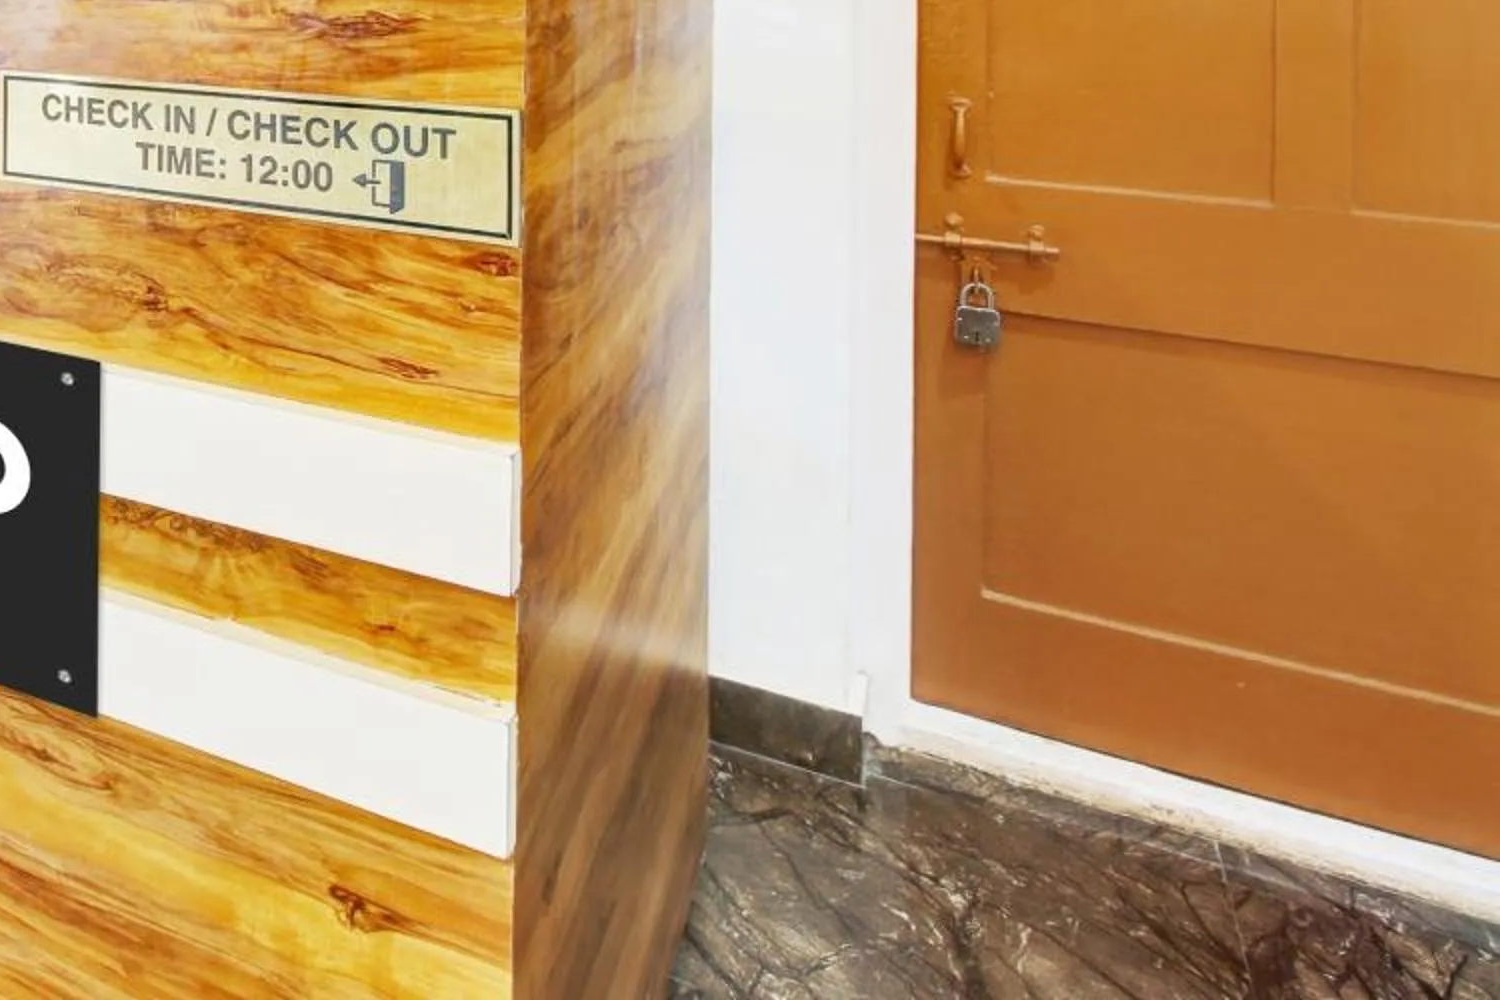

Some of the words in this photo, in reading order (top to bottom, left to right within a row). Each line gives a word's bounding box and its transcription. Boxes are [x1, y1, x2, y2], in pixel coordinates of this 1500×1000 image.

[41, 93, 154, 132] CHECK
[164, 107, 197, 136] IN
[227, 110, 359, 151] CHECK
[370, 122, 458, 160] OUT
[135, 140, 227, 180] TIME:
[240, 154, 334, 192] 12:00
